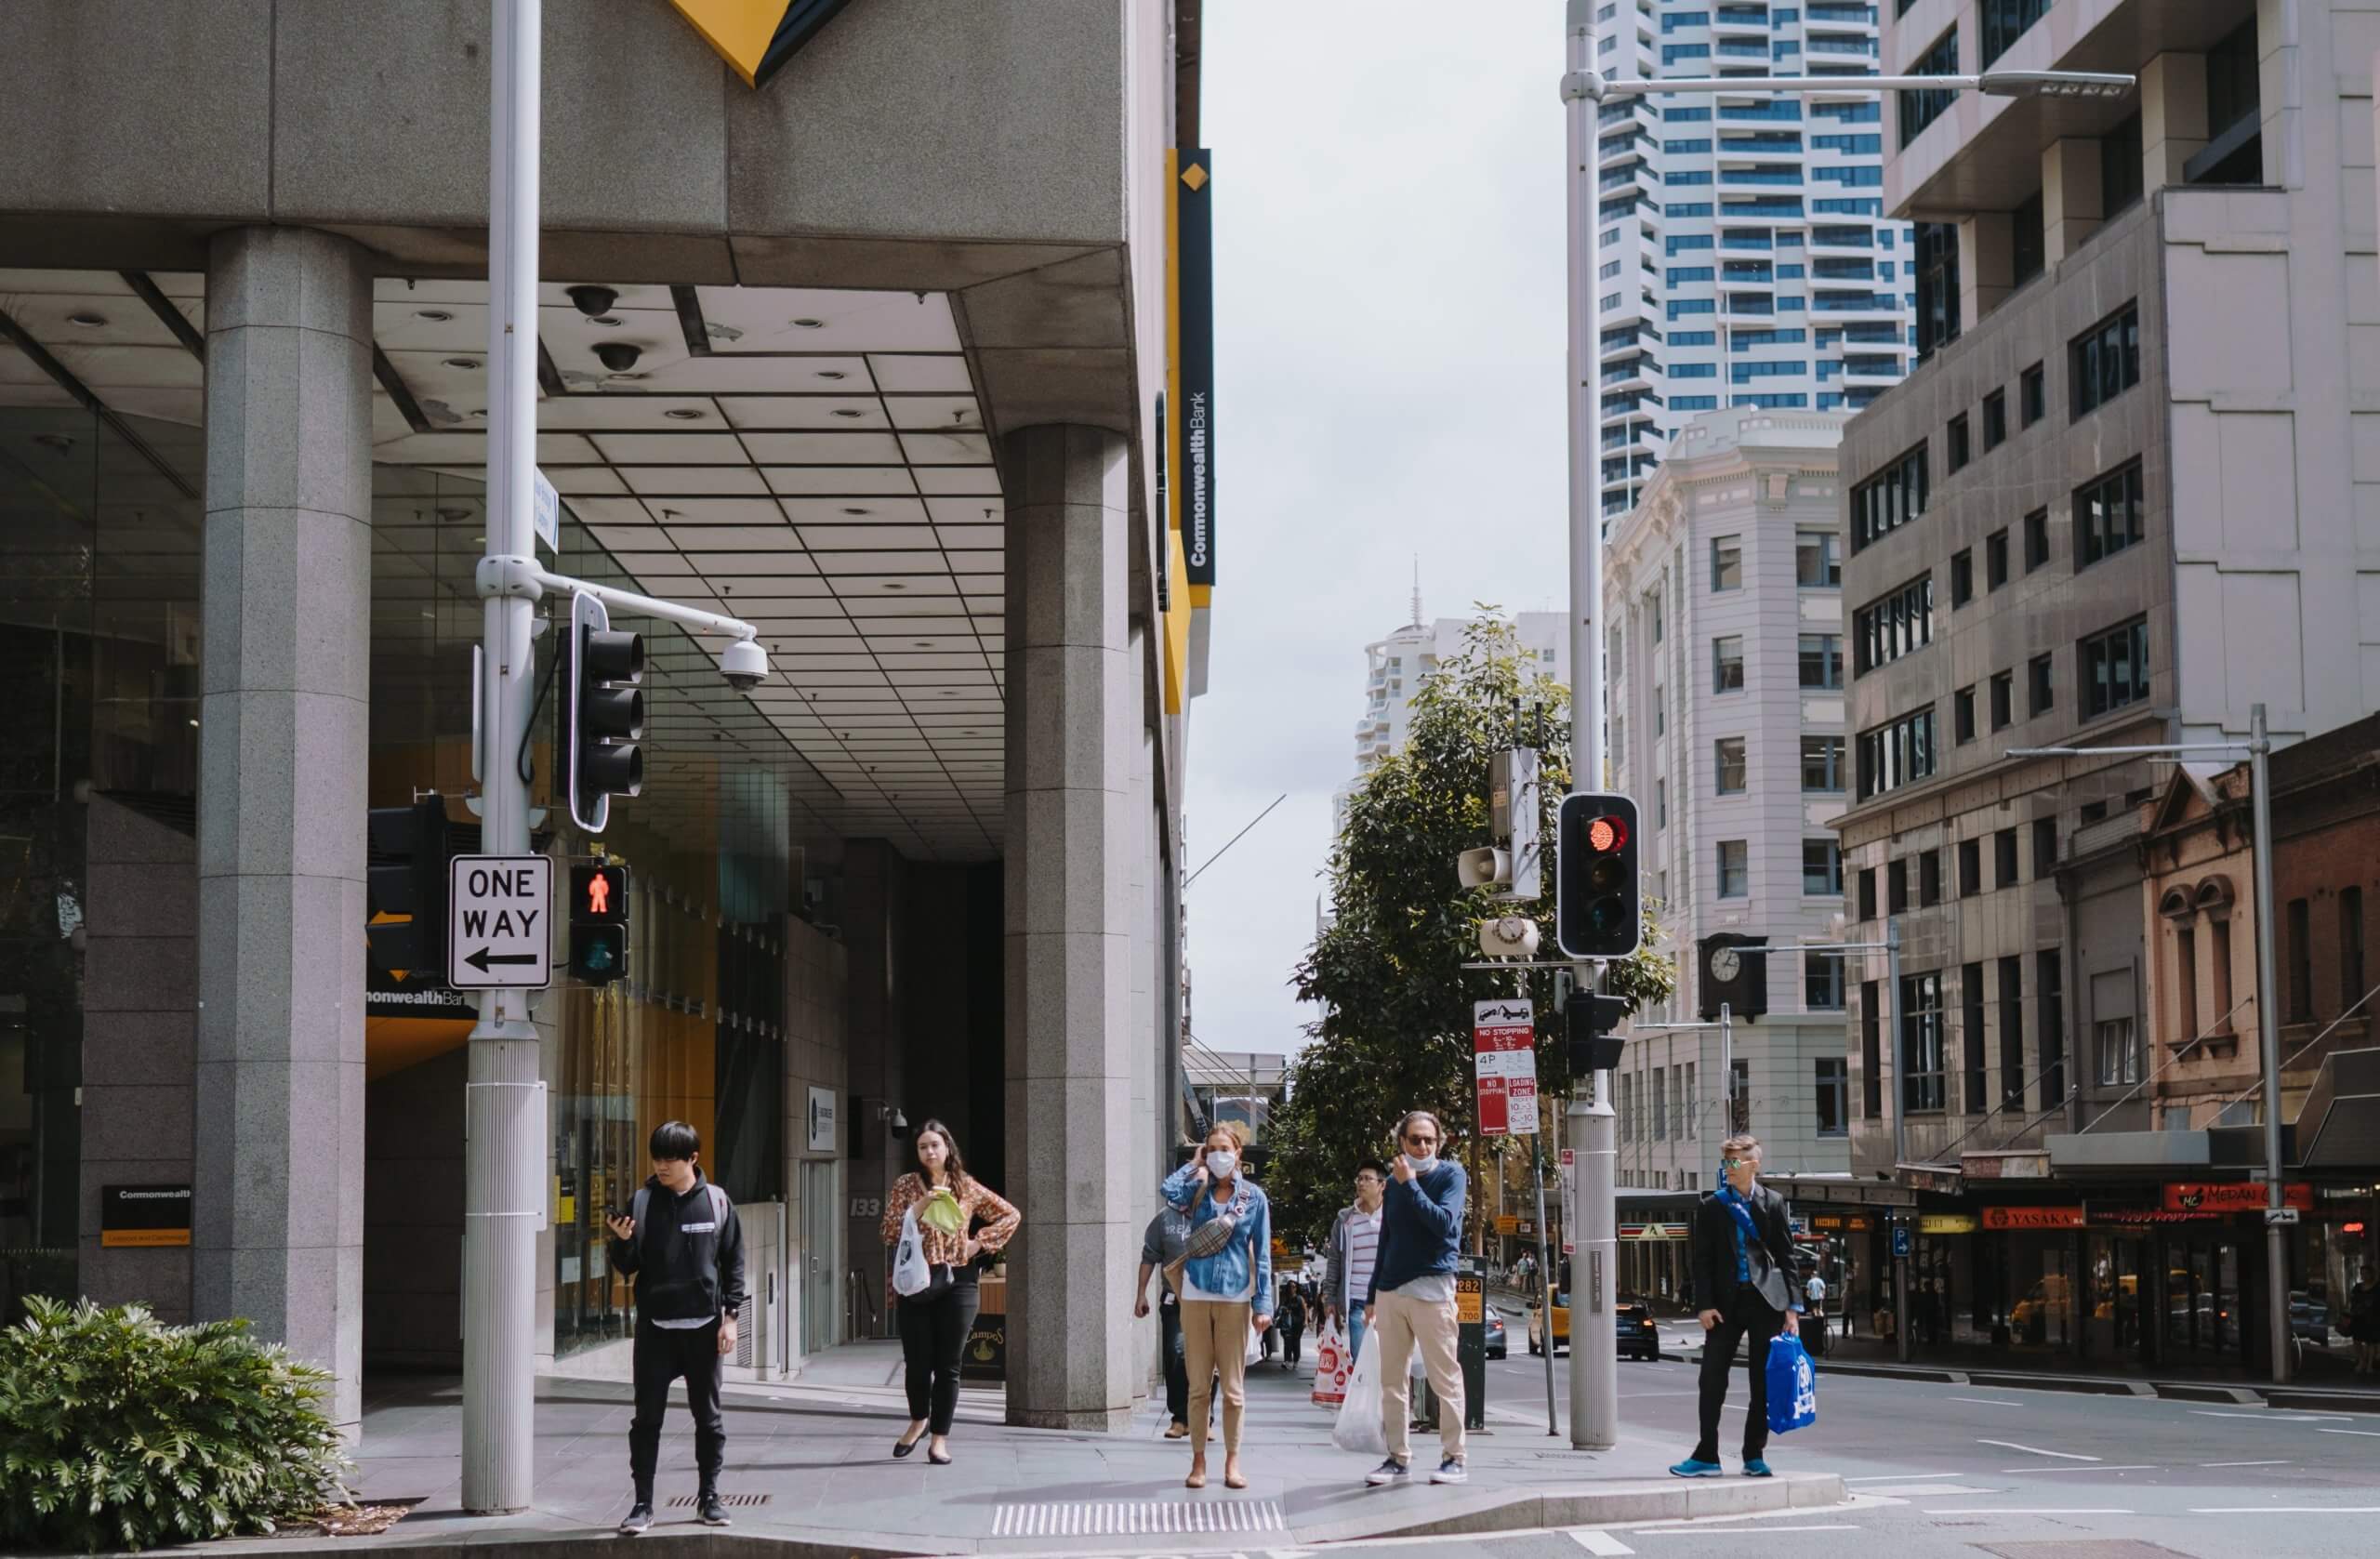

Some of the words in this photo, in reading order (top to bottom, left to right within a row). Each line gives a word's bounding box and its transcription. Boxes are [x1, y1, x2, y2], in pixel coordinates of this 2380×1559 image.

[1190, 392, 1206, 567] CommonwealthBank
[469, 869, 535, 898] ONE
[463, 910, 539, 938] WAY
[1493, 1027, 1529, 1036] STOPPING
[1479, 1054, 1496, 1064] 4P
[1487, 1079, 1497, 1088] NO
[1509, 1078, 1534, 1088] LOADING
[1479, 1087, 1506, 1095] STOPPING
[1513, 1088, 1532, 1096] ZONE
[850, 1198, 880, 1217] 133
[2013, 1214, 2071, 1224] YASAKA
[1897, 1230, 1905, 1242] P
